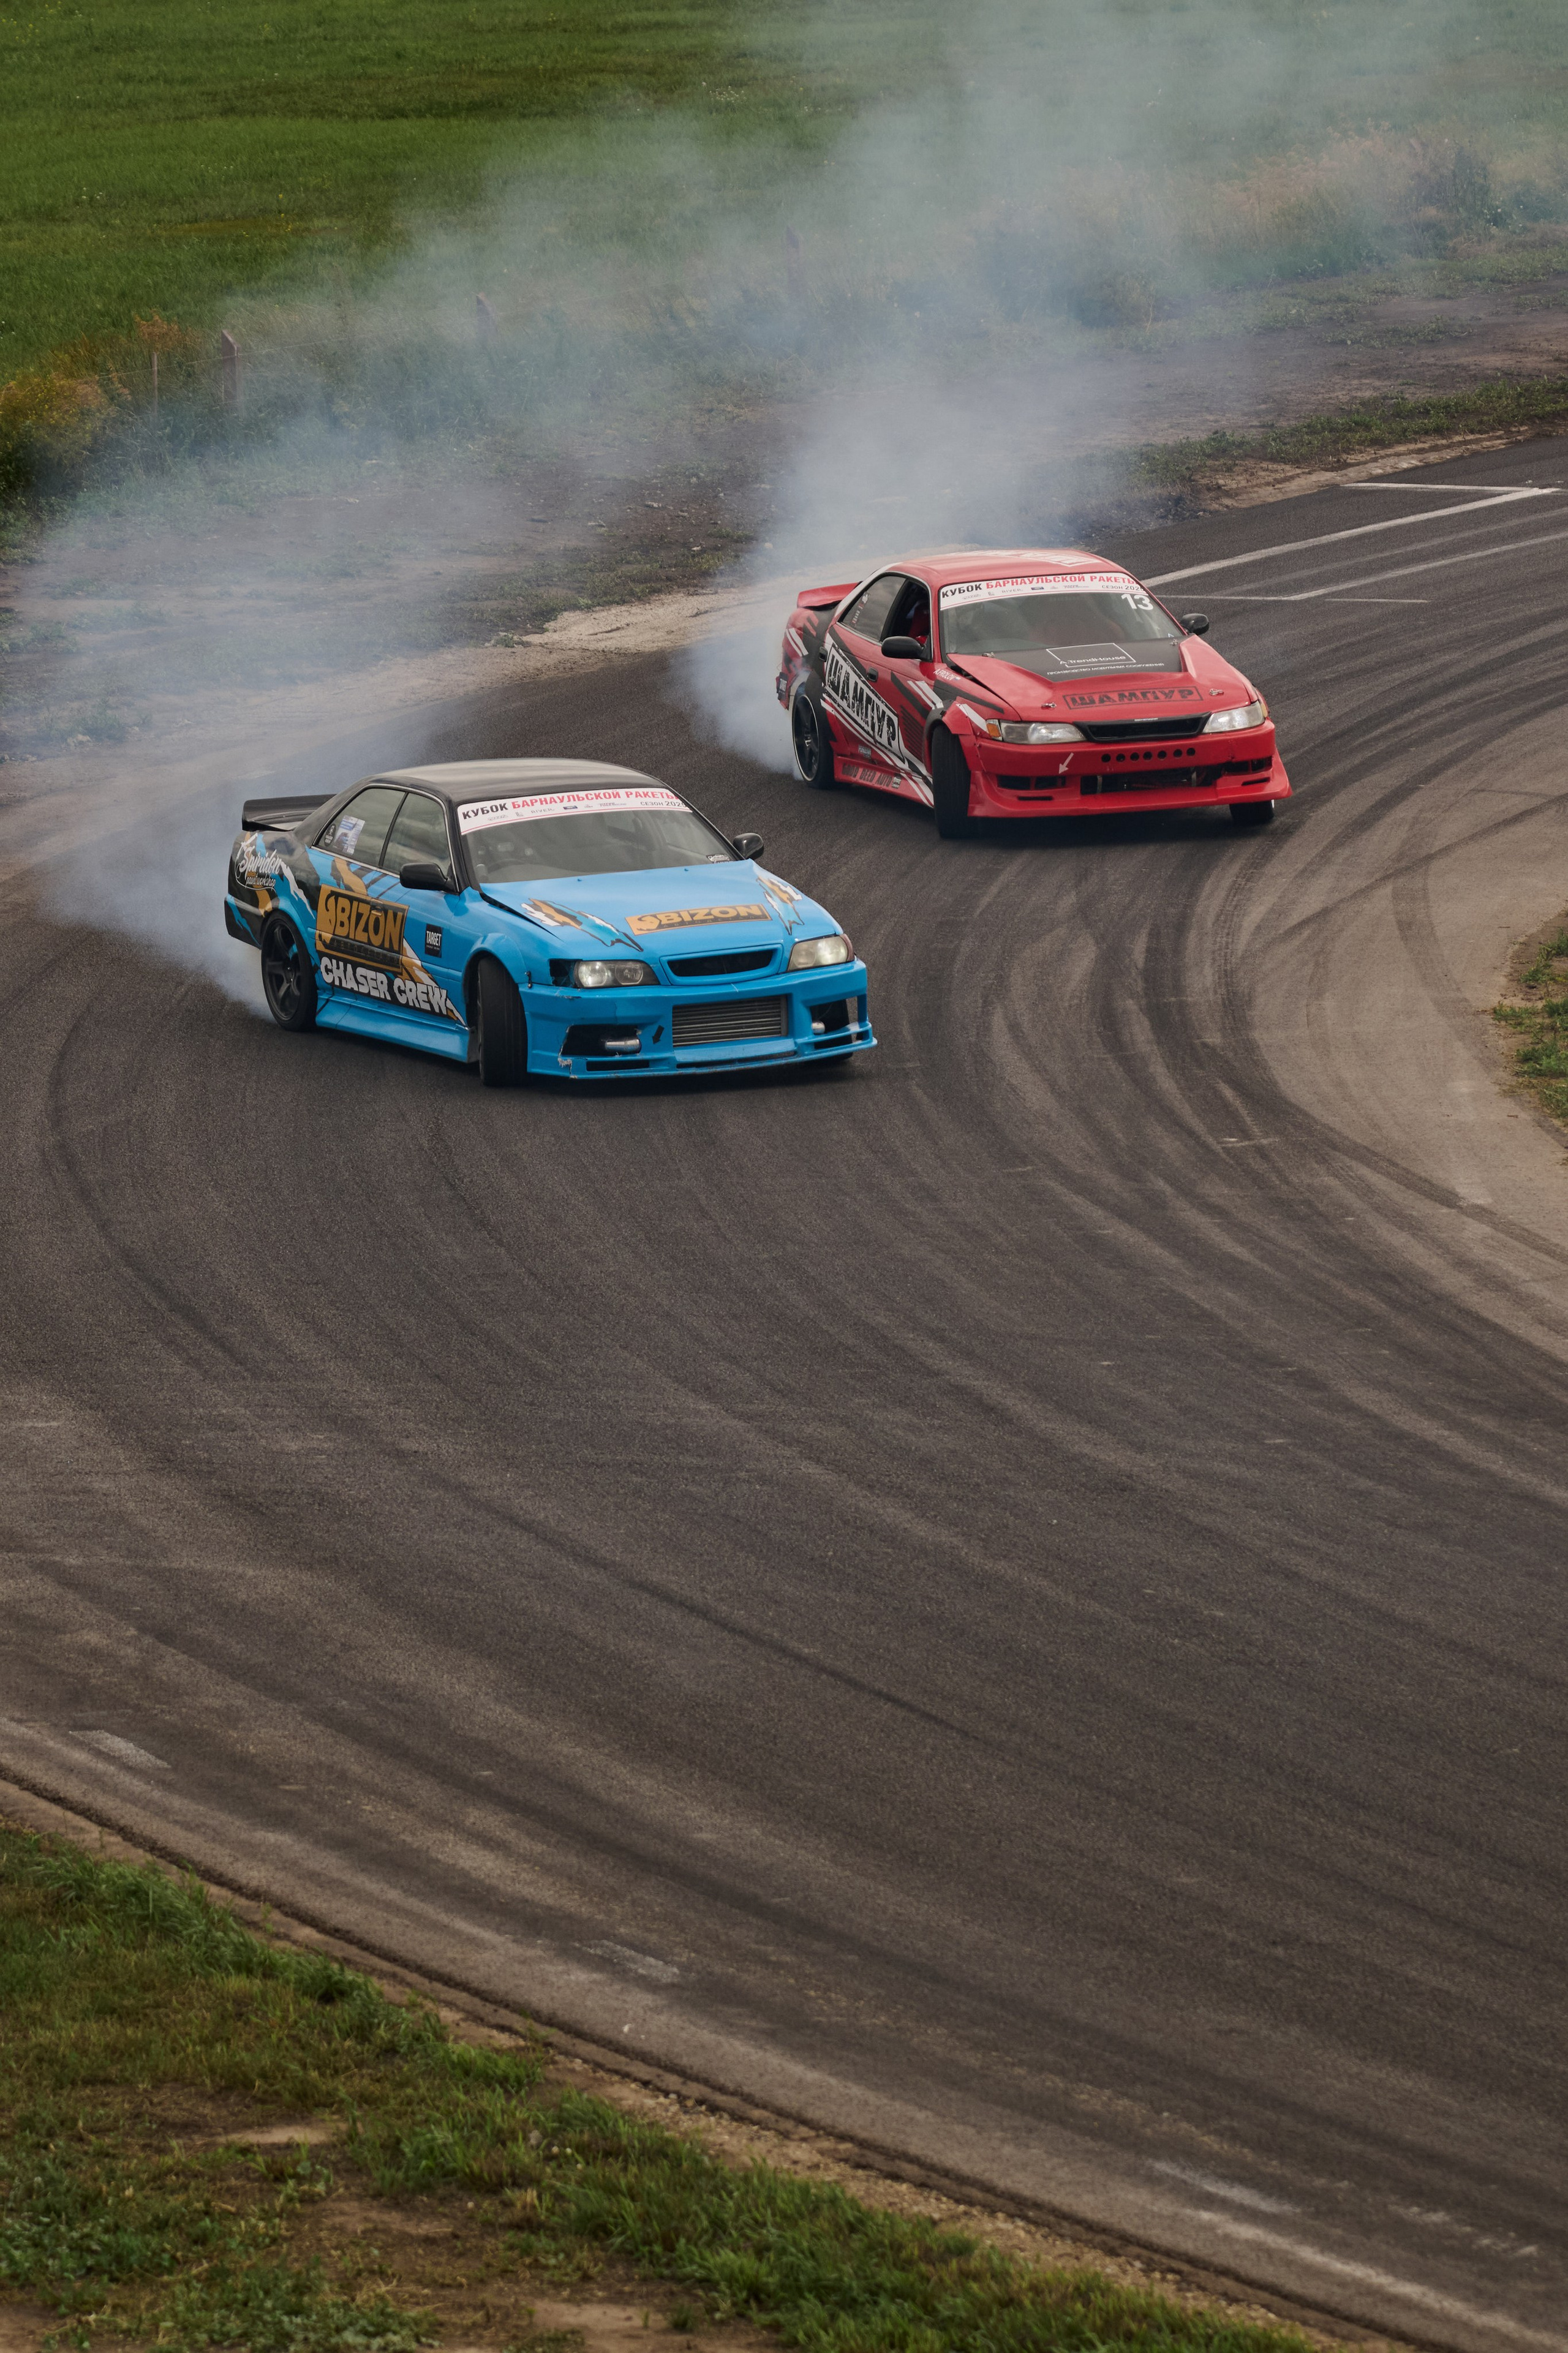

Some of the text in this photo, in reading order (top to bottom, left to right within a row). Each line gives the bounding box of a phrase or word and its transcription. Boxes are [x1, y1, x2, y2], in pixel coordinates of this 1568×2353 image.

[941, 583, 982, 598] КУБОК
[986, 573, 1085, 589] БАРНАУЛЬСКОЙ
[1121, 593, 1153, 610] 13
[1060, 655, 1126, 664] A.TrendHouse
[827, 653, 896, 747] ШАМПУР
[1069, 689, 1194, 707] ШАМПУР
[462, 789, 679, 819] КУБОК БАРНАУЛЬСКОЙ РАКЕТЫ
[335, 896, 403, 950] BIZON
[656, 905, 763, 925] BIZON
[426, 930, 442, 946] TARGET
[320, 957, 447, 1015] CHASER CREW
